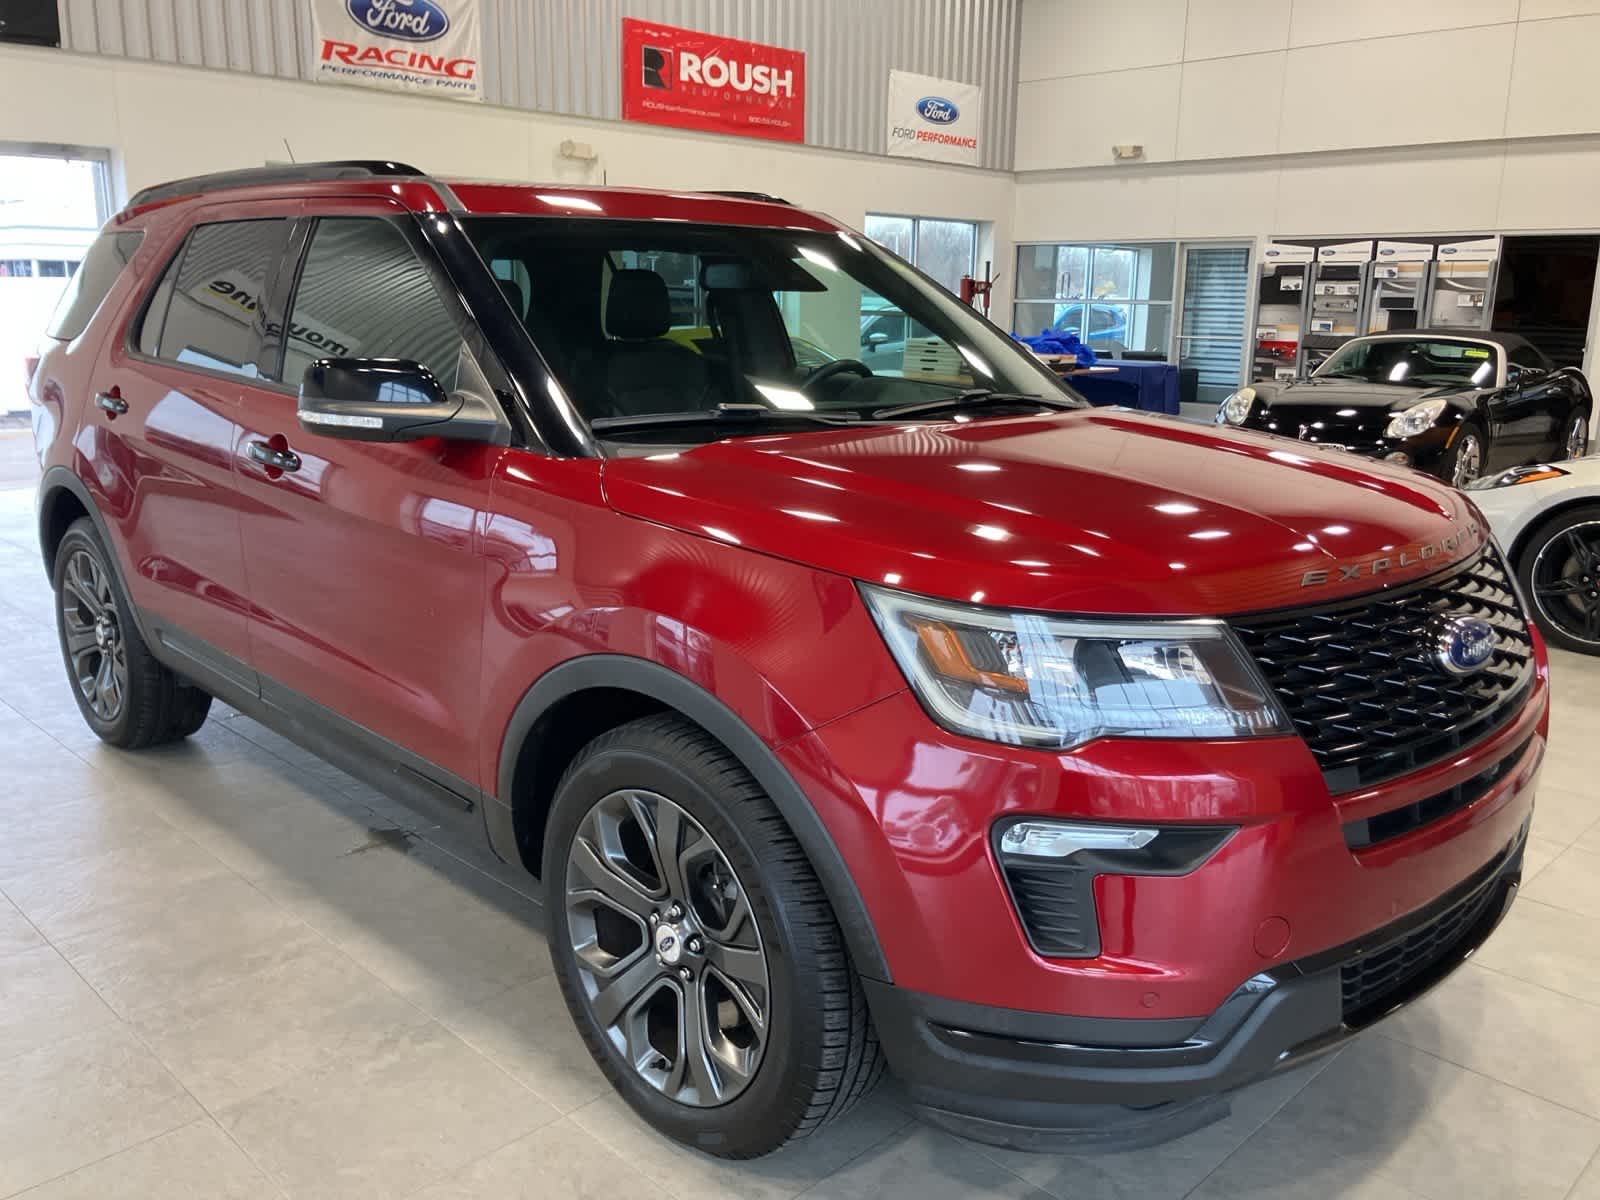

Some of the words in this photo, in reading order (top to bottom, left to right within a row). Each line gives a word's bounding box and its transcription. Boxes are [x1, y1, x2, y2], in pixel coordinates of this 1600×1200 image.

[366, 0, 431, 36] Ford
[320, 39, 476, 80] RACING
[679, 51, 793, 98] ROUSH
[321, 64, 434, 85] PERFORMANCE
[436, 79, 477, 91] PARTS
[924, 100, 952, 121] Ford
[892, 127, 916, 140] FORD
[916, 131, 977, 149] PERFORMANCE
